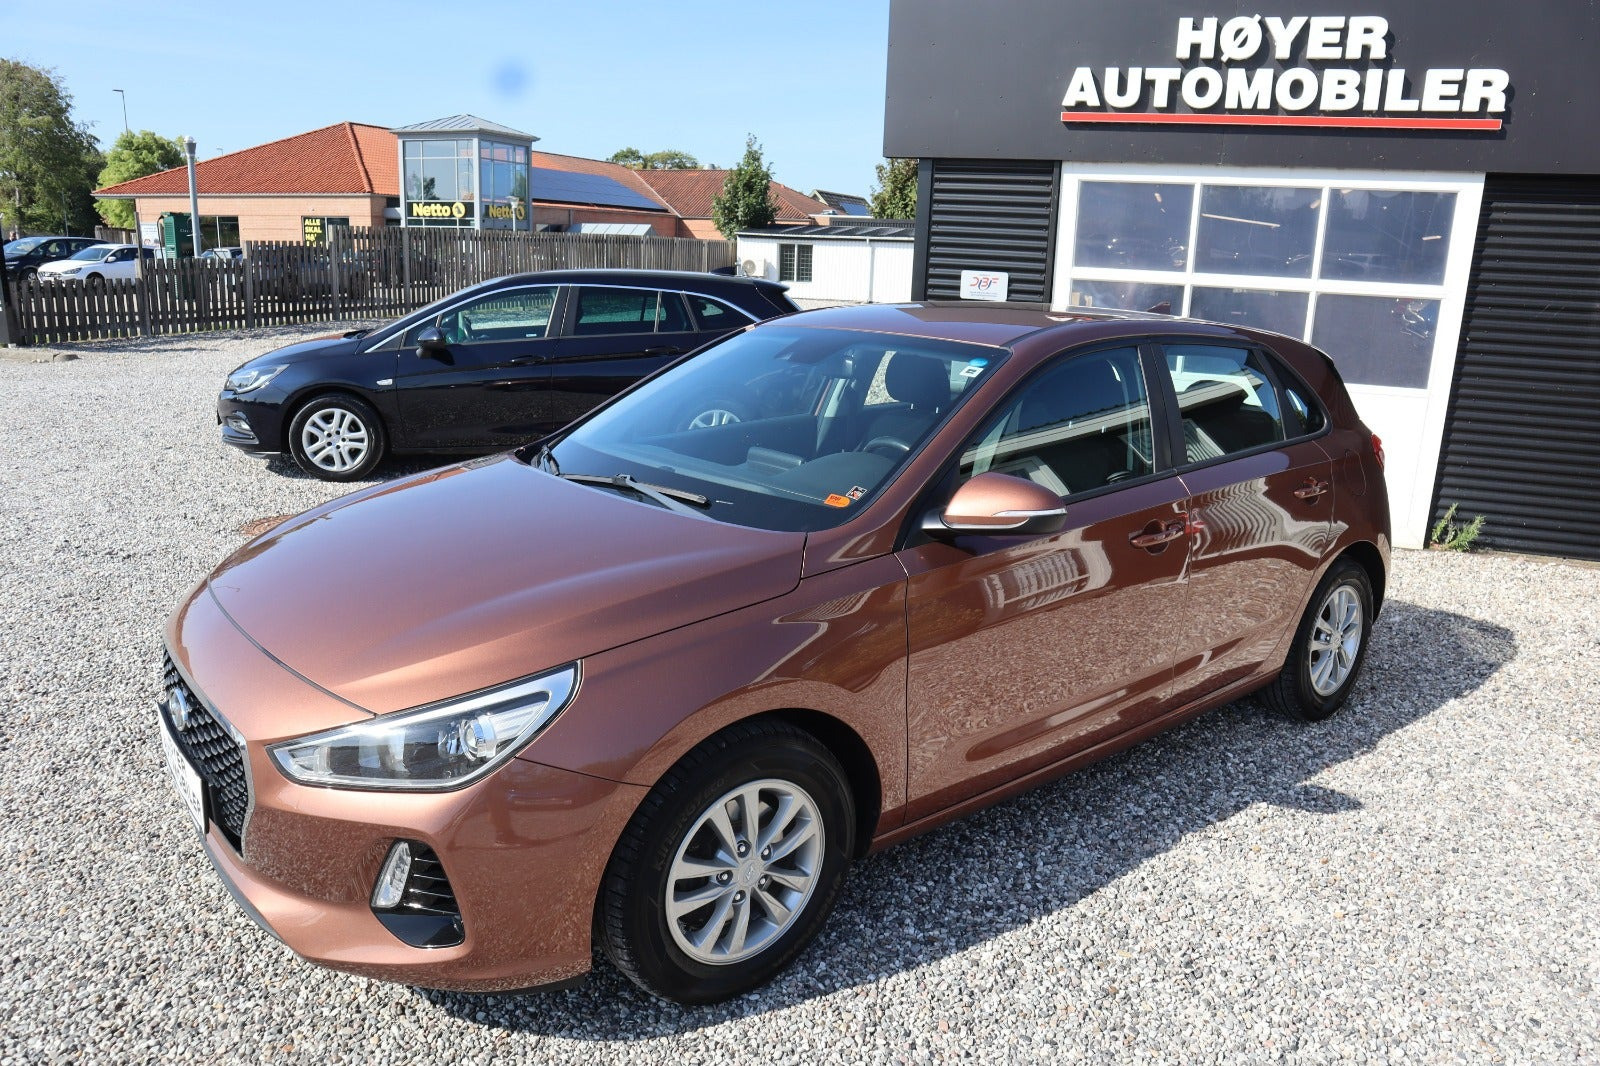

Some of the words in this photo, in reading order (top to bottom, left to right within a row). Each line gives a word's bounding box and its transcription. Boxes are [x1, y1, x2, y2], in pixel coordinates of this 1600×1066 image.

[1176, 14, 1389, 62] HØYER
[1061, 66, 1511, 113] AUTOMOBILER
[412, 202, 451, 217] Netto
[304, 218, 321, 226] ALLE
[304, 226, 323, 234] SKAL
